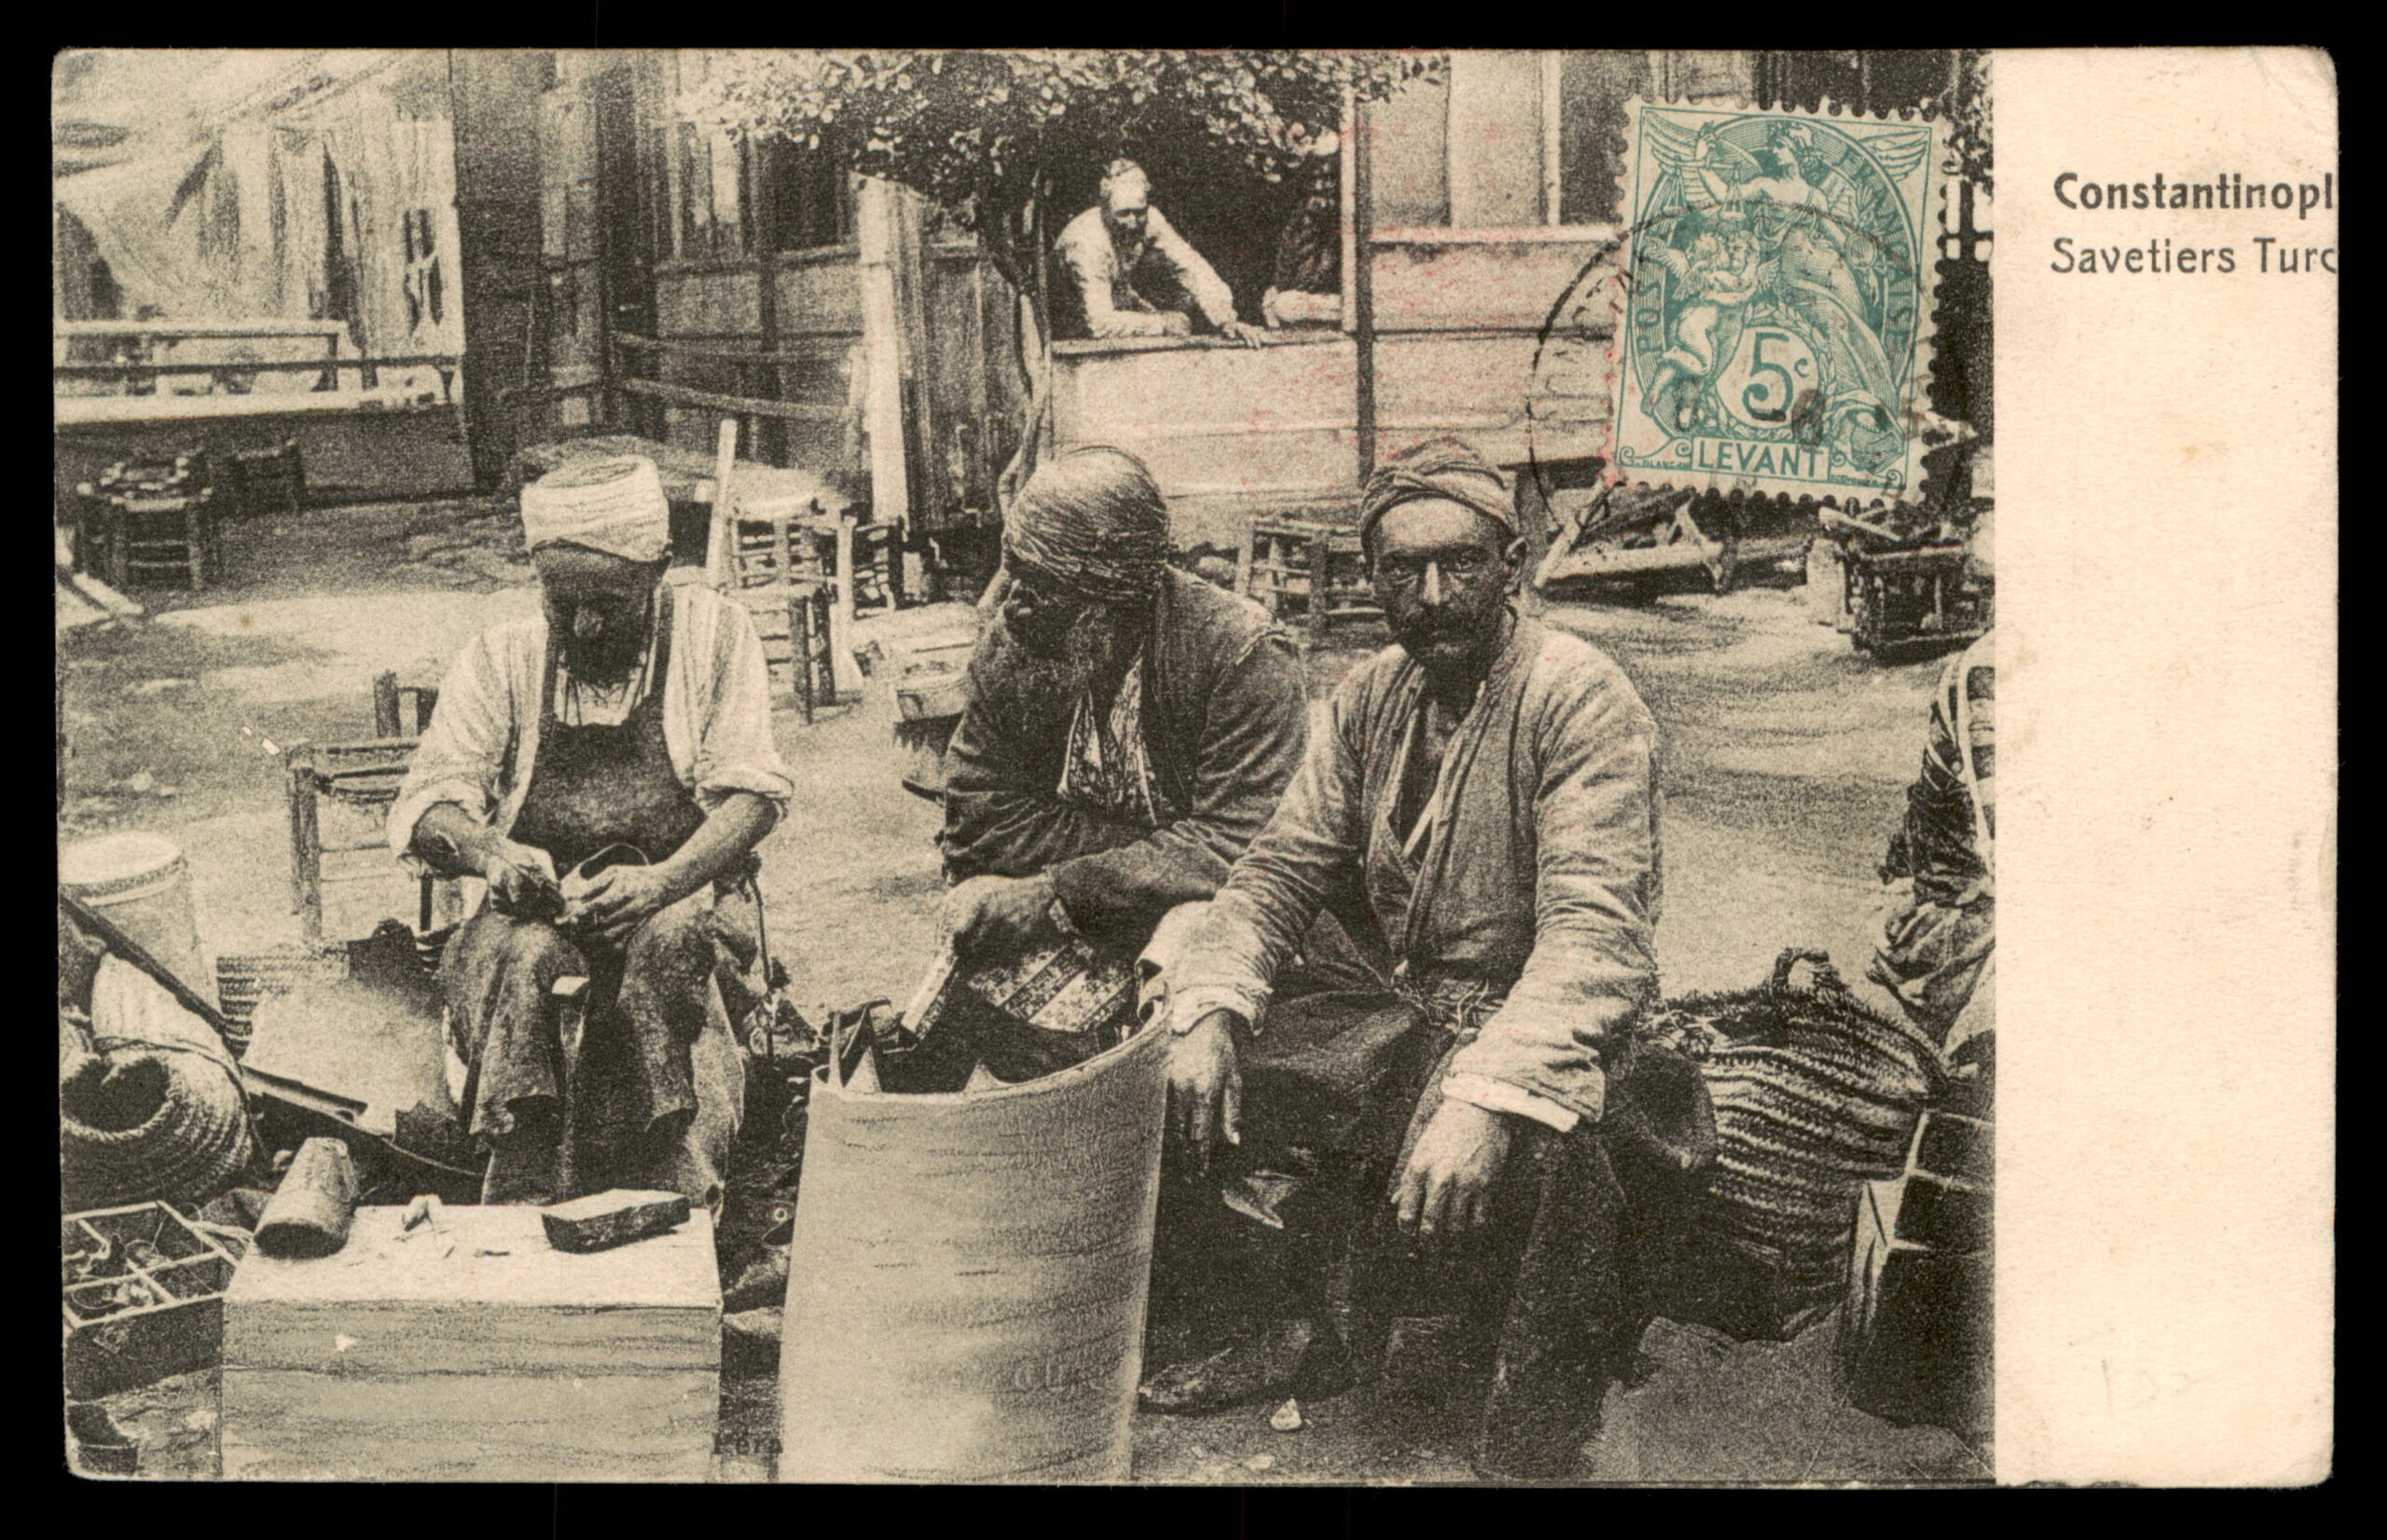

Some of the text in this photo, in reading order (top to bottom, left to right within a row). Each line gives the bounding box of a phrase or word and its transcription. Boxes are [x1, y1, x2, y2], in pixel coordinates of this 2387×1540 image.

[2053, 172, 2333, 220] Constantinopl
[2050, 237, 2236, 274] Savetiers
[1698, 439, 1825, 478] LEVANT
